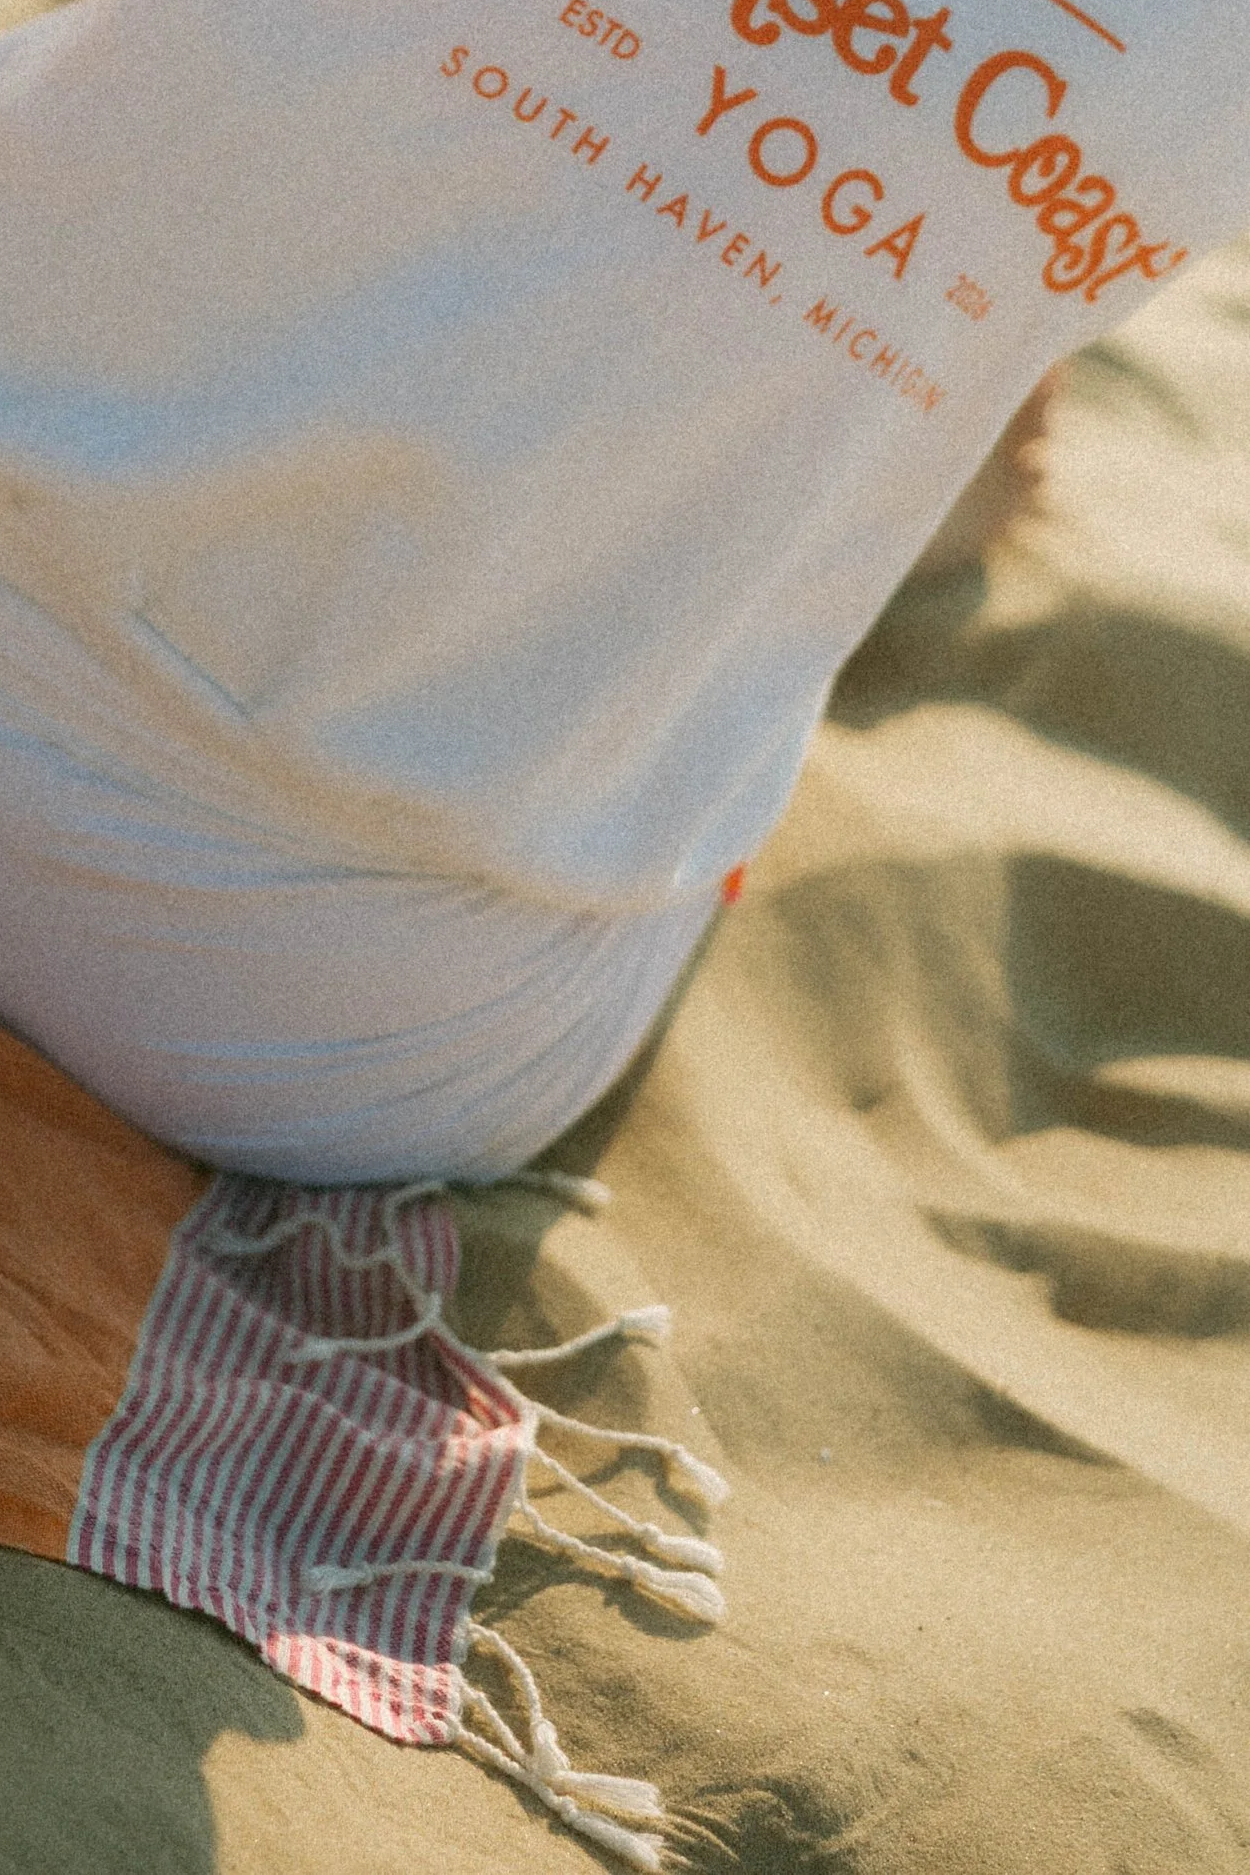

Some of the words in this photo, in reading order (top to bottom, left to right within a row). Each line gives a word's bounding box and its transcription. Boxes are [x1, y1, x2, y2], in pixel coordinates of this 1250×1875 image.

[440, 45, 611, 166] SOUTH
[624, 162, 782, 305] HAVEN,
[695, 64, 925, 280] YOGA
[954, 50, 1188, 304] Coast
